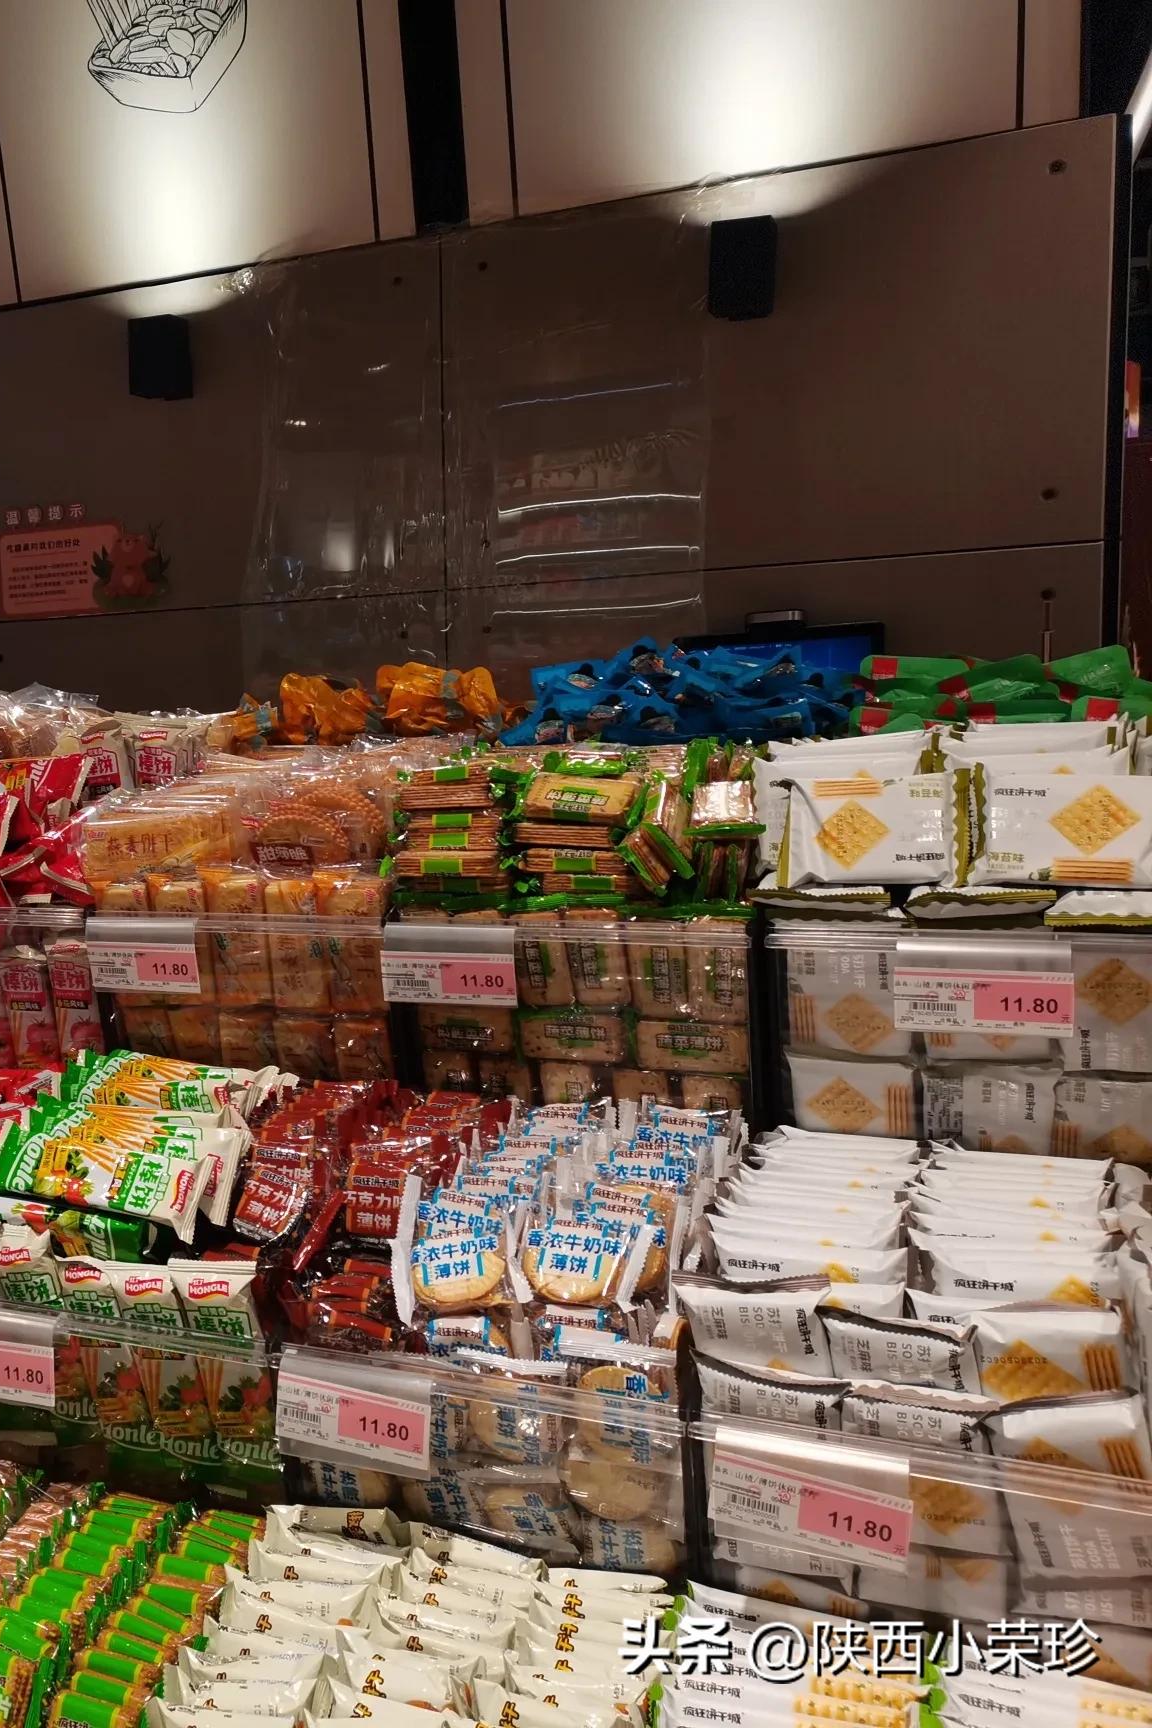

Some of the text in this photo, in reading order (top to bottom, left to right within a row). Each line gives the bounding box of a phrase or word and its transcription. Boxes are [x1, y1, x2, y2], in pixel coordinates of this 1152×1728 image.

[6, 503, 84, 526] 温馨提示
[151, 962, 189, 977] 11.80
[459, 973, 505, 989] 11.80
[999, 996, 1059, 1015] 11.80
[352, 1175, 400, 1189] 疯狂饼干城
[595, 1162, 688, 1185] 香浓牛奶味
[129, 1159, 164, 1211] 棒饼
[173, 1169, 193, 1215] HONGLE
[248, 1200, 280, 1224] 薄饼
[356, 1211, 392, 1231] 薄饼
[418, 1202, 503, 1236] 香浓牛奶味
[410, 1235, 498, 1265] 香浓牛奶味
[527, 1230, 624, 1257] 香浓牛奶味
[65, 1268, 101, 1280] HONGLE
[434, 1259, 471, 1279] 薄饼
[550, 1252, 589, 1275] 薄饼
[728, 1258, 780, 1273] 疯狂饼干城
[4, 1279, 50, 1301] 棒饼
[125, 1280, 163, 1292] HONGLE
[189, 1282, 229, 1295] HONGLE
[953, 1278, 1016, 1293] 疯狂饼干城
[193, 1315, 245, 1338] 棒饼
[543, 1314, 598, 1330] 疯狂饼干城
[711, 1306, 728, 1340] 芝麻味
[795, 1307, 816, 1357] 疯狂饼干城
[856, 1338, 874, 1374] 芝麻味
[3, 1364, 45, 1386] 11.80
[358, 1414, 410, 1442] 11.80
[827, 1510, 906, 1556] 11.80 元
[683, 1678, 742, 1699] 疯狂饼干城
[683, 1705, 742, 1725] 疯狂饼干城
